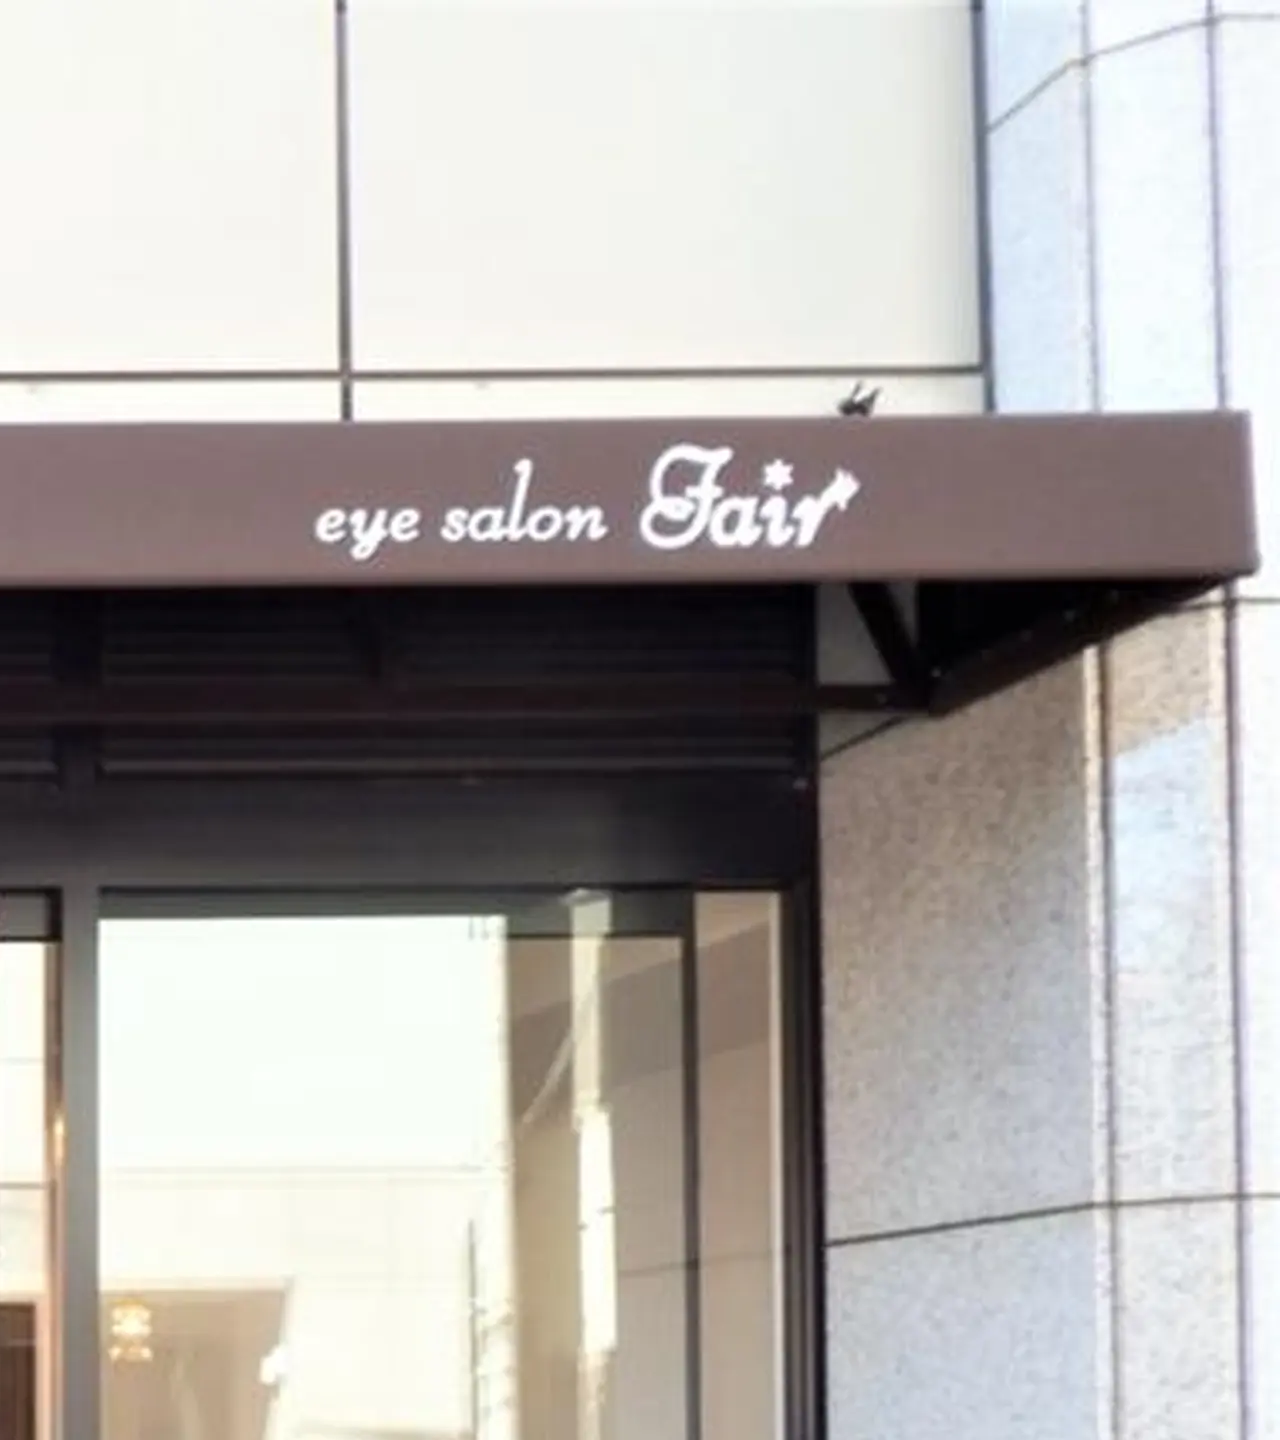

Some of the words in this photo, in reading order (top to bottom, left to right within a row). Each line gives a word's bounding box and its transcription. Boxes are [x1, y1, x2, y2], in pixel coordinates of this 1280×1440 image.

[313, 506, 421, 560] eye
[438, 457, 608, 542] salon
[639, 442, 860, 549] Fair
